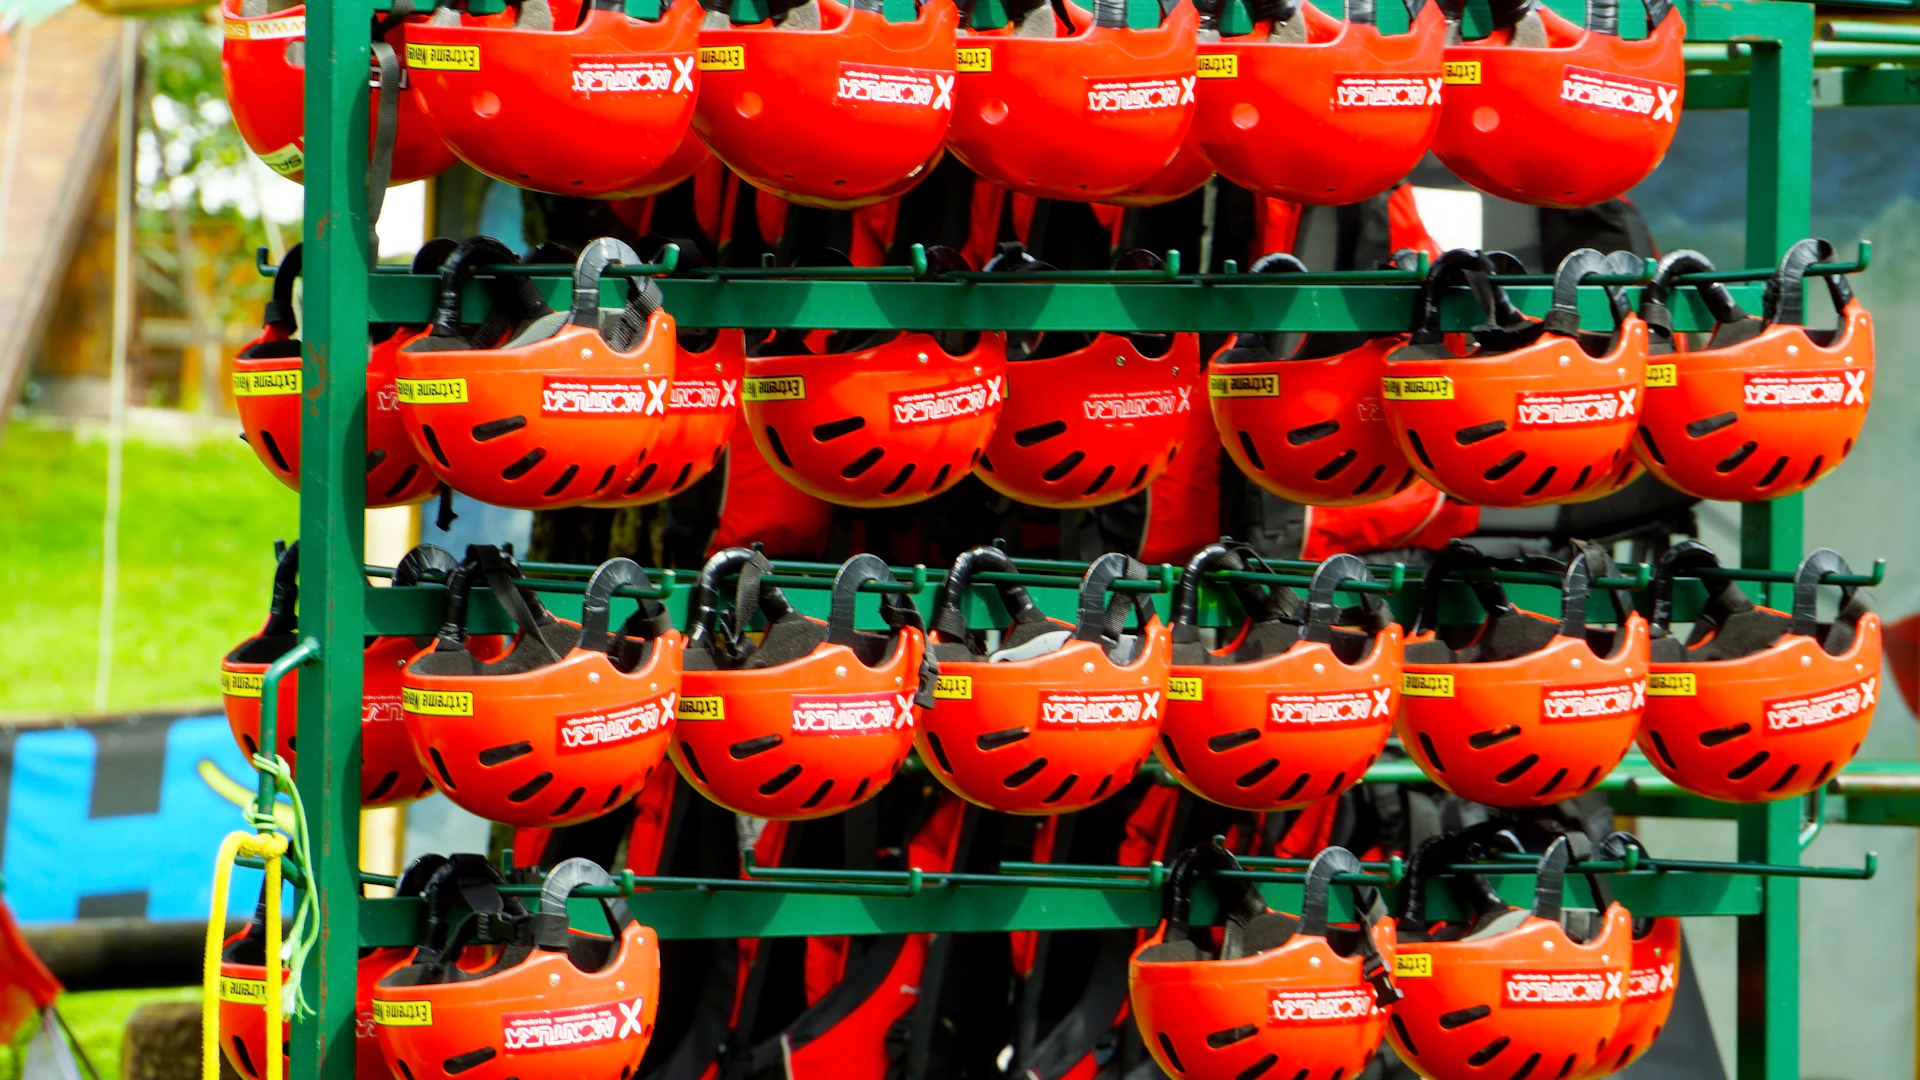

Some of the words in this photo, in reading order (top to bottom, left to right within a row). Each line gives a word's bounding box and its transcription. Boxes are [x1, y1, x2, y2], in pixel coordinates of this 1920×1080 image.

[431, 49, 475, 67] Extreme
[571, 70, 672, 91] MONTURA
[837, 78, 934, 105] MONTURA
[1088, 87, 1181, 111] MONTURA
[1337, 86, 1427, 106] MONTURA
[1561, 80, 1656, 115] MONTURA
[254, 374, 296, 391] Extreme
[418, 382, 461, 399] Extreme
[1744, 382, 1845, 405] MONTURA
[541, 390, 646, 412] MONTURA
[893, 391, 987, 423] MONTURA
[1517, 399, 1619, 424] MONTURA
[422, 695, 468, 712] Extreme
[1042, 701, 1142, 723] MONTURA
[1271, 699, 1372, 723] MONTURA
[1543, 691, 1632, 718] MONTURA
[1767, 692, 1861, 729] MONTURA
[561, 708, 660, 747] MONTURA
[792, 707, 895, 730] MONTURA
[1507, 980, 1606, 1002] MONTURA
[386, 1004, 427, 1022] Extreme
[1272, 996, 1371, 1020] MONTURA
[504, 1017, 617, 1049] MONTURA
